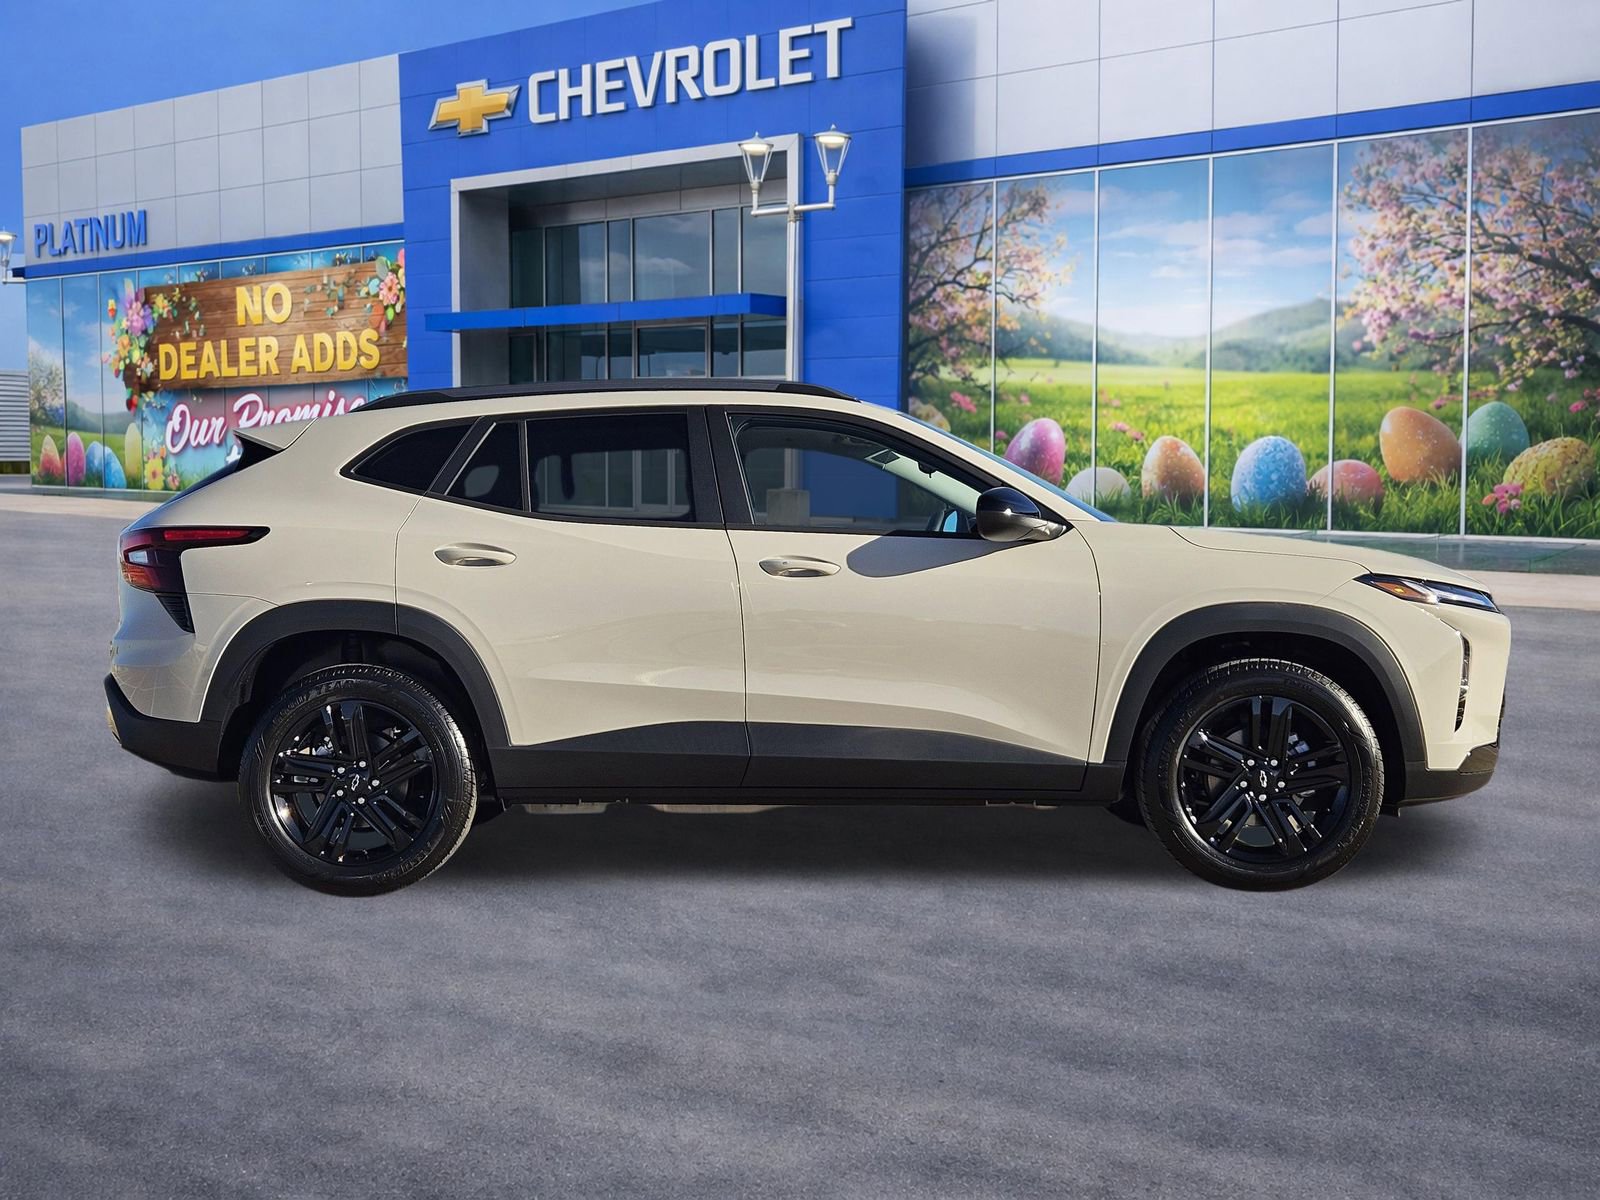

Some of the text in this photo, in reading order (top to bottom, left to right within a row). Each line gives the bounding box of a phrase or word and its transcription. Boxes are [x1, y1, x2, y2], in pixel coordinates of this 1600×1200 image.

[528, 16, 853, 124] CHEVROLET
[34, 209, 147, 258] PLATINUM
[235, 283, 292, 326] NO
[158, 328, 381, 381] DEALER ADDS
[165, 403, 227, 454] Our
